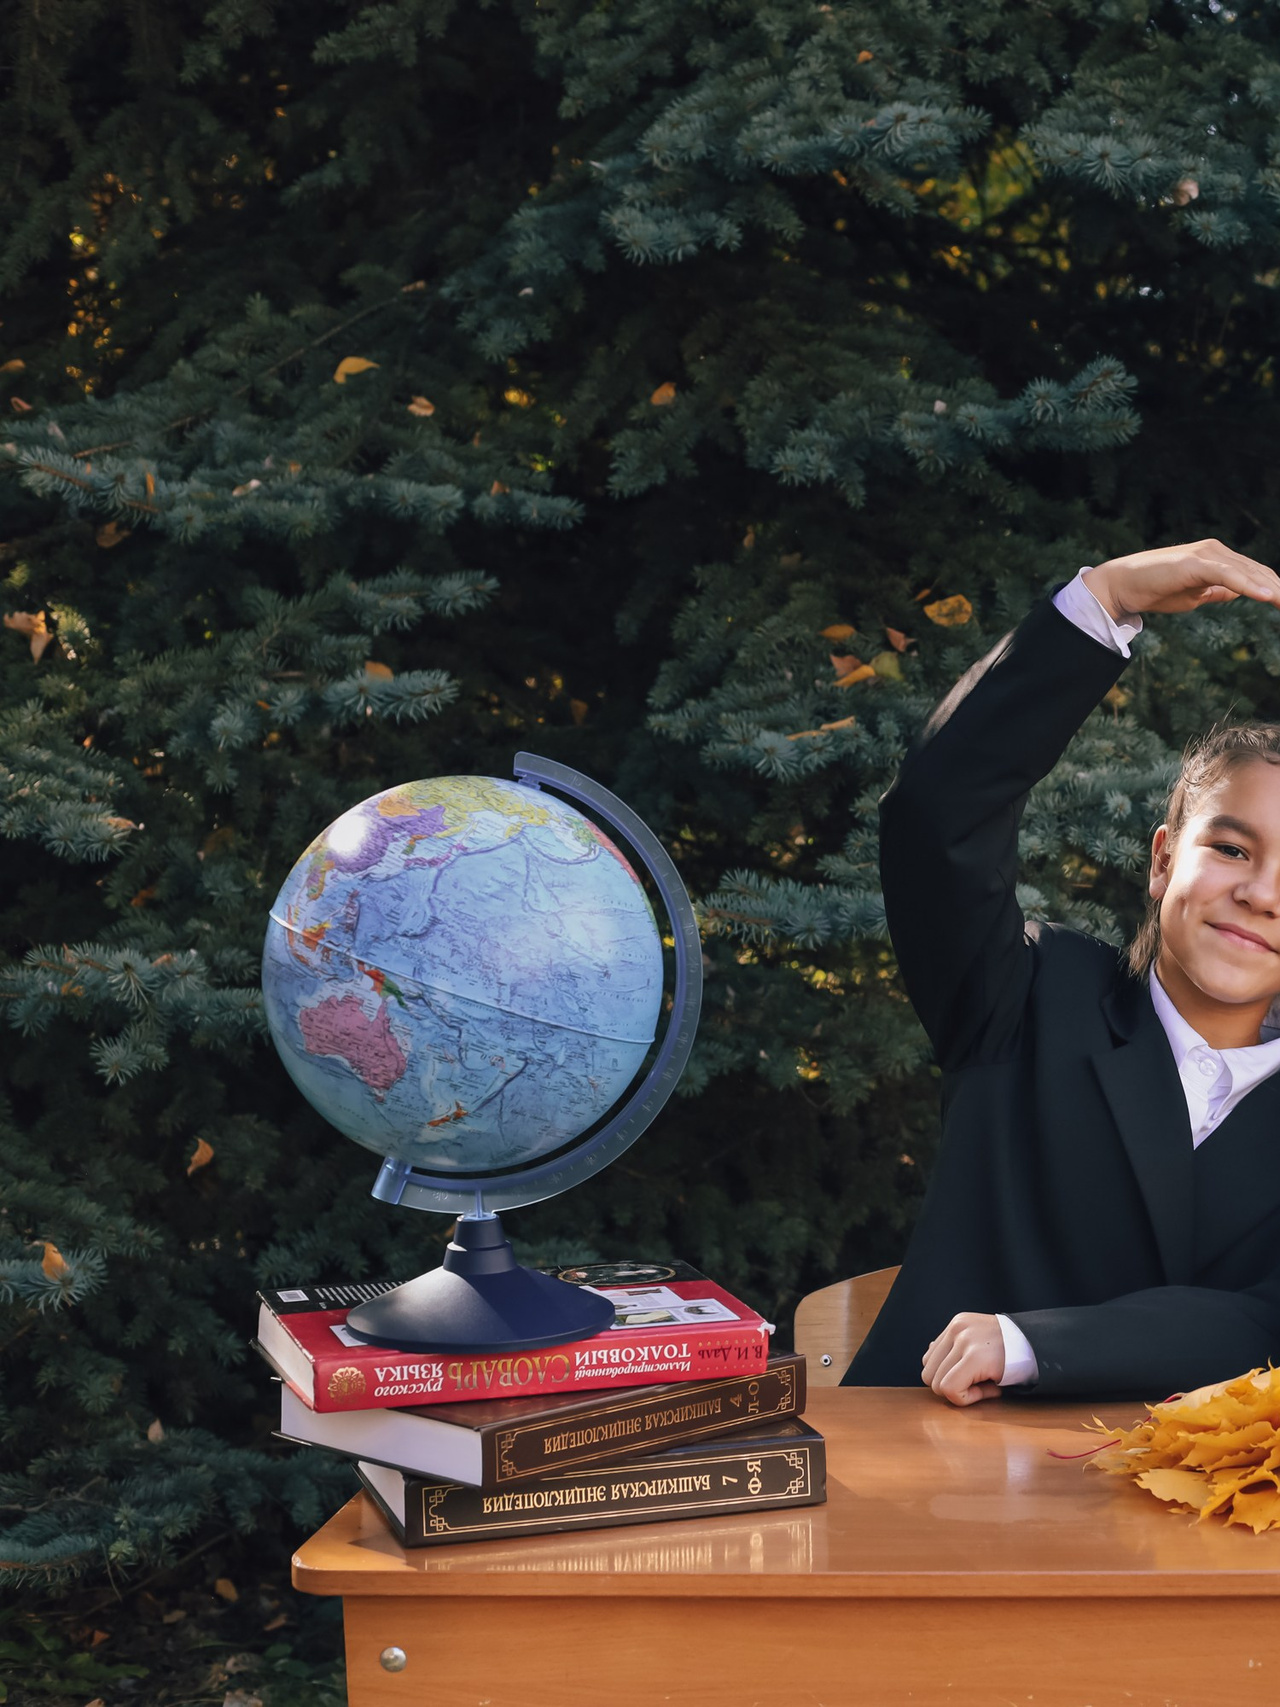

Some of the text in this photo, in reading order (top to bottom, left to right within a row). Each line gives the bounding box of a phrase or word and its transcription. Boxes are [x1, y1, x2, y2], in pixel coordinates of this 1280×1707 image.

[574, 1343, 692, 1371] ТОЛКОВЫЙ
[698, 1345, 733, 1362] Даль
[374, 1362, 444, 1383] ЯЗЫКА
[447, 1355, 571, 1391] СЛОВАРЬ
[574, 1360, 692, 1380] Иллюстрированный
[374, 1377, 444, 1398] русского
[543, 1397, 722, 1455] БАШКИРСКАЯ ЭНЦИКЛОПЕДИЯ
[483, 1474, 711, 1514] БАШКИРСКАЯ ЭНЦИКЛОПЕДИЯ
